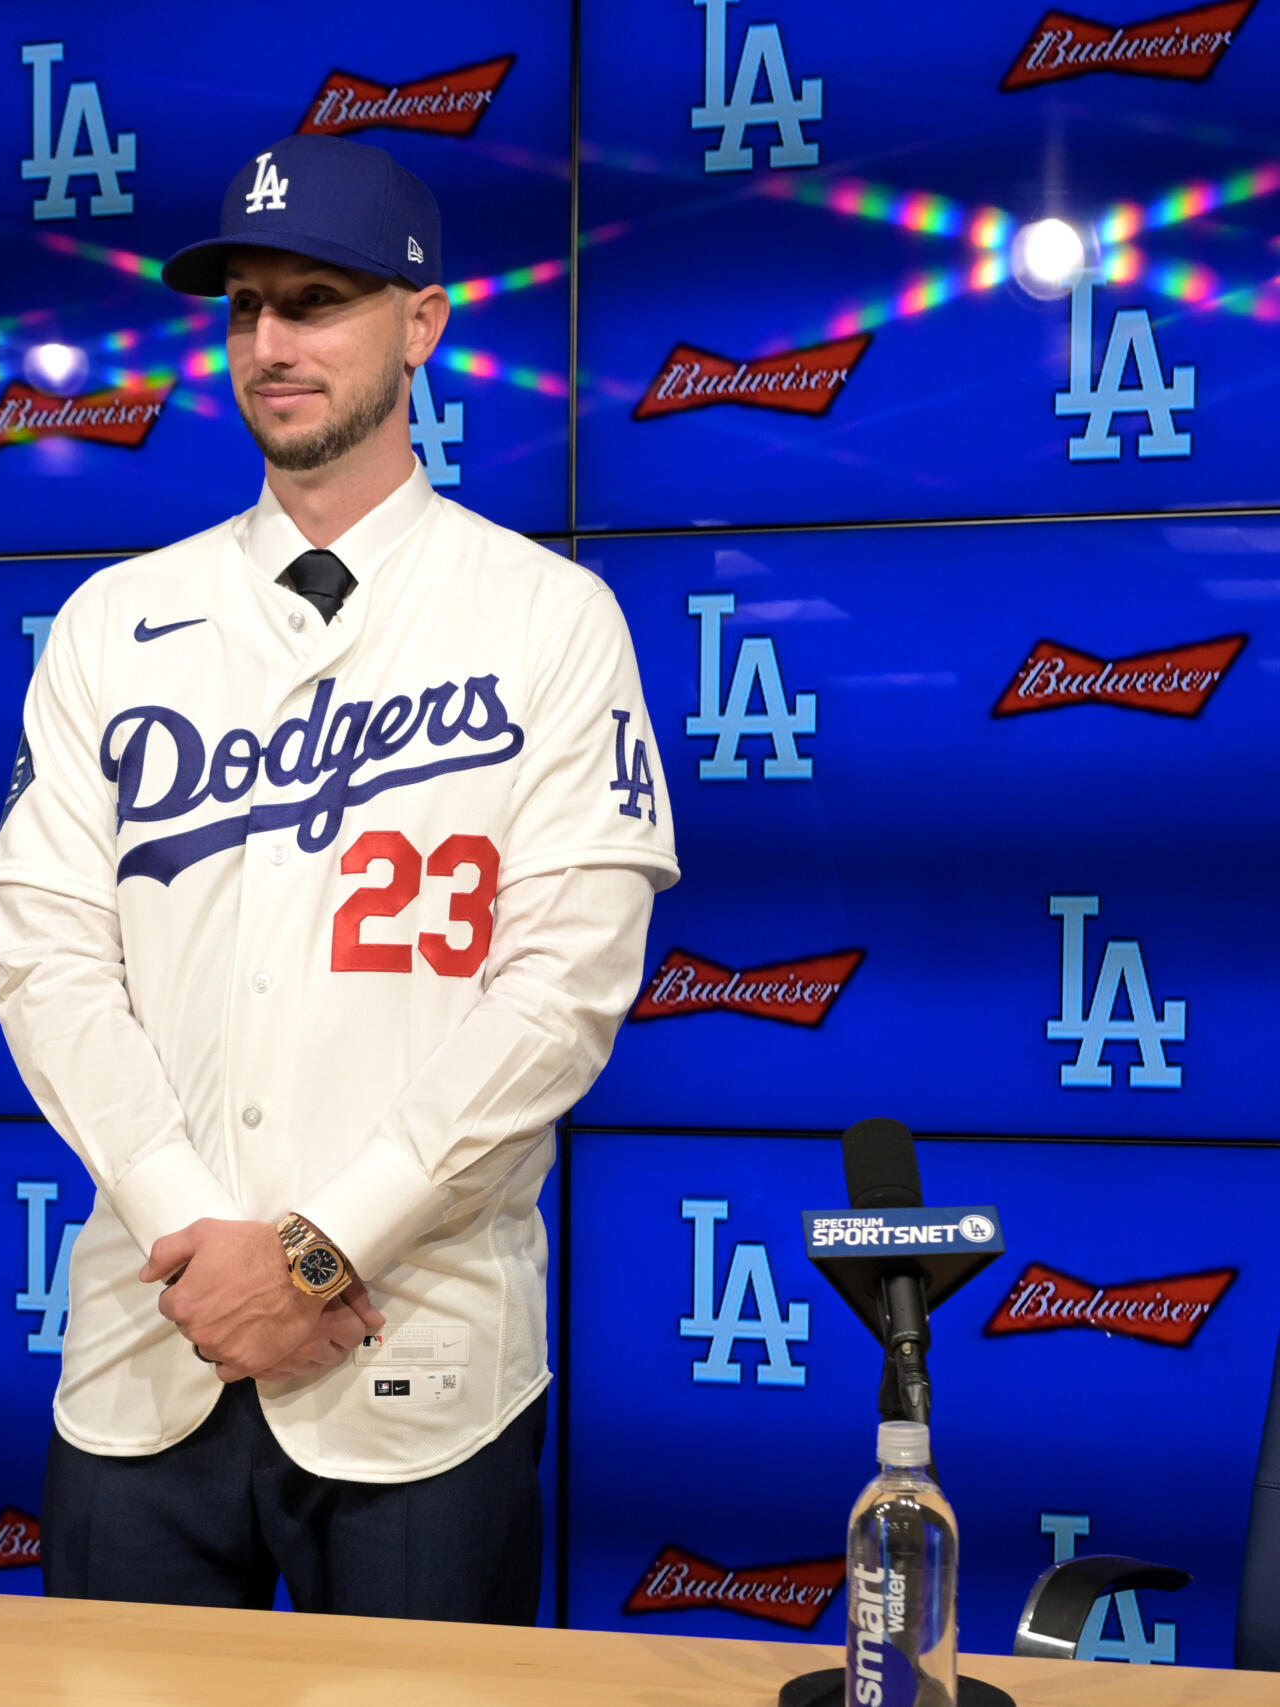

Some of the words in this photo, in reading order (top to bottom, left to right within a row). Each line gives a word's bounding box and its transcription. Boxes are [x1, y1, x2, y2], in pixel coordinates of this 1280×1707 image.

[1026, 26, 1232, 70] Budweiser
[313, 86, 492, 126] Budweiser
[692, 0, 823, 173] LA
[21, 43, 137, 219] LA
[246, 152, 288, 213] LA
[657, 360, 850, 401] Budweiser
[1056, 270, 1196, 460] LA
[686, 593, 817, 780] LA
[1017, 657, 1221, 699] Budweiser
[100, 673, 523, 853] Dodgers
[610, 709, 657, 827] LA
[330, 830, 501, 978] 23
[652, 967, 839, 1005] Budweiser
[1046, 895, 1186, 1088] LA
[812, 1224, 960, 1246] SPORTSNET
[813, 1217, 884, 1229] SPECTRUM
[969, 1219, 986, 1238] LA
[680, 1199, 809, 1387] LA
[1009, 1280, 1210, 1326] Budweiser
[647, 1562, 833, 1606] Budweiser
[885, 1568, 907, 1633] water
[854, 1562, 886, 1707] smart
